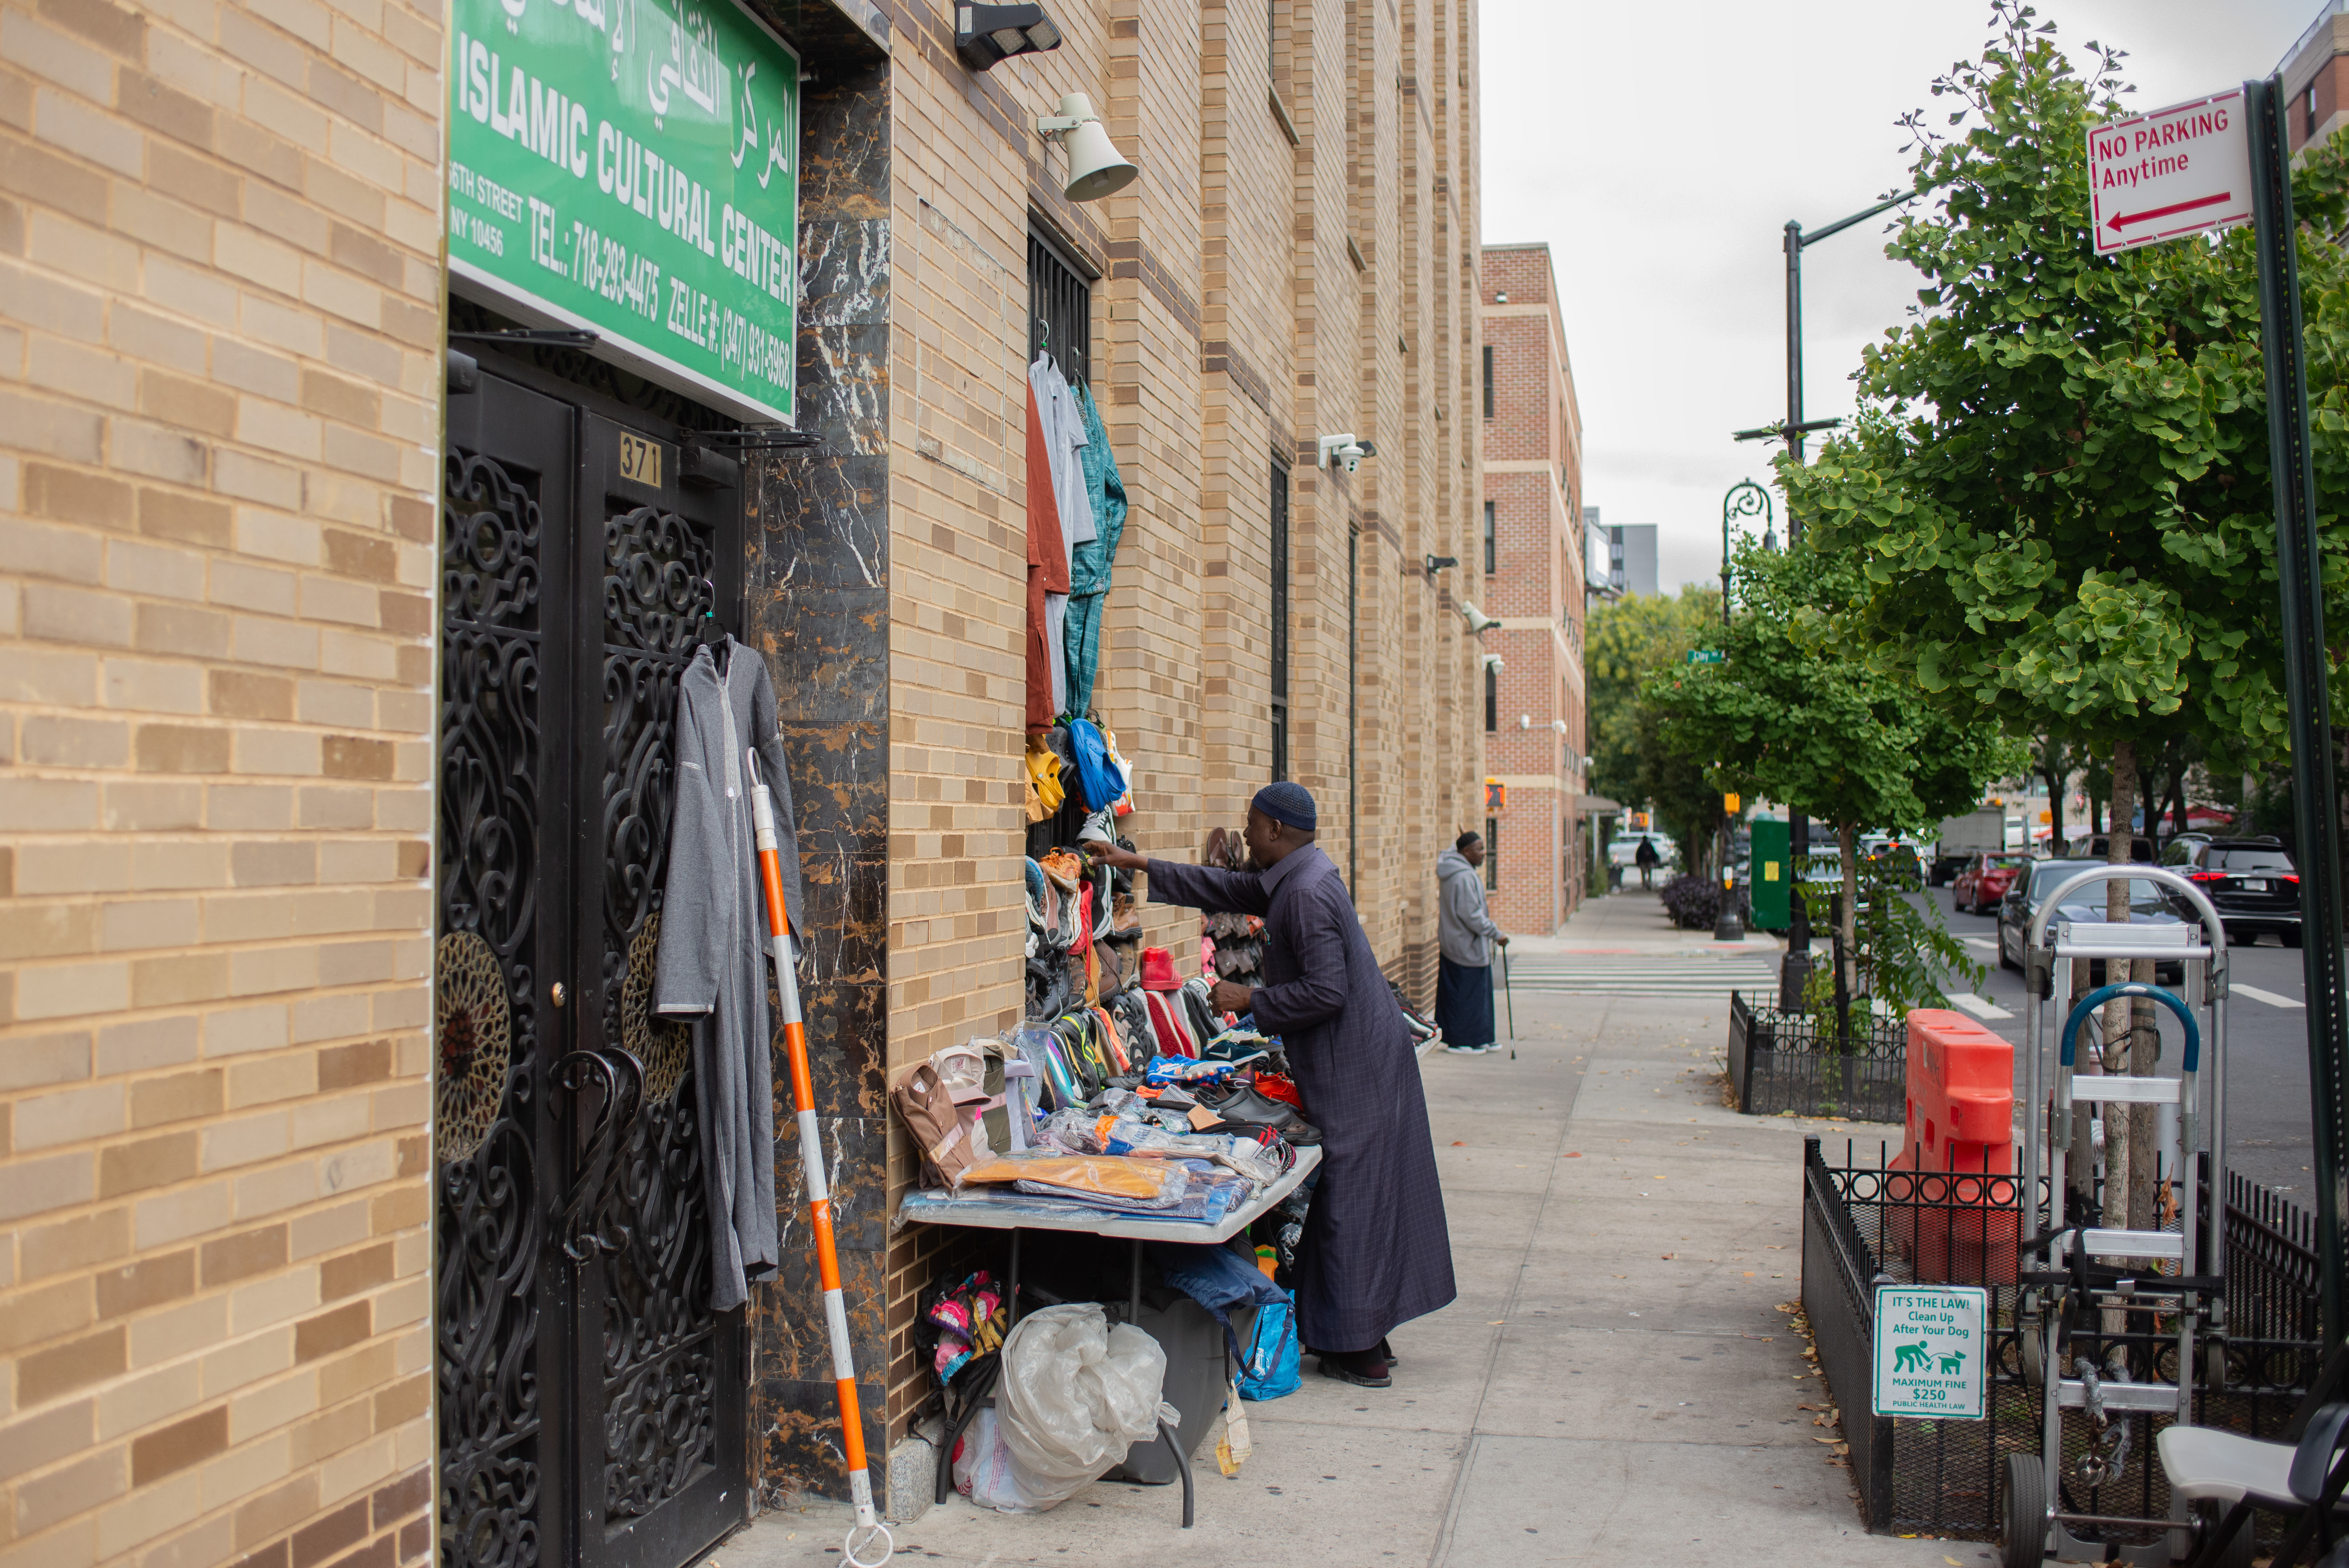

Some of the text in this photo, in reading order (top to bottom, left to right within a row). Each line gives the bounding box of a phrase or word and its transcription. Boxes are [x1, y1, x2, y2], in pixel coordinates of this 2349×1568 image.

[731, 62, 792, 189] المركز
[2099, 109, 2228, 162] NO PARKING
[460, 31, 792, 307] ISLAMIC CULTURAL CENTER
[2102, 154, 2189, 190] Anytime
[477, 174, 523, 224] STREET
[451, 205, 503, 257] NY 10456
[2125, 239, 2159, 249] Transportation
[573, 221, 661, 323] 718-293-4475
[667, 276, 708, 348] ZELLE
[721, 306, 747, 381] (347)
[748, 326, 791, 391] 931-5968
[622, 437, 657, 484] 371
[1893, 1297, 1969, 1310] IT'S THE LAW!
[1908, 1311, 1954, 1325] Clean Up
[1893, 1323, 1969, 1339] After Your Dog
[1893, 1378, 1966, 1389] MAXIMUM FINE
[1912, 1387, 1946, 1401] $250
